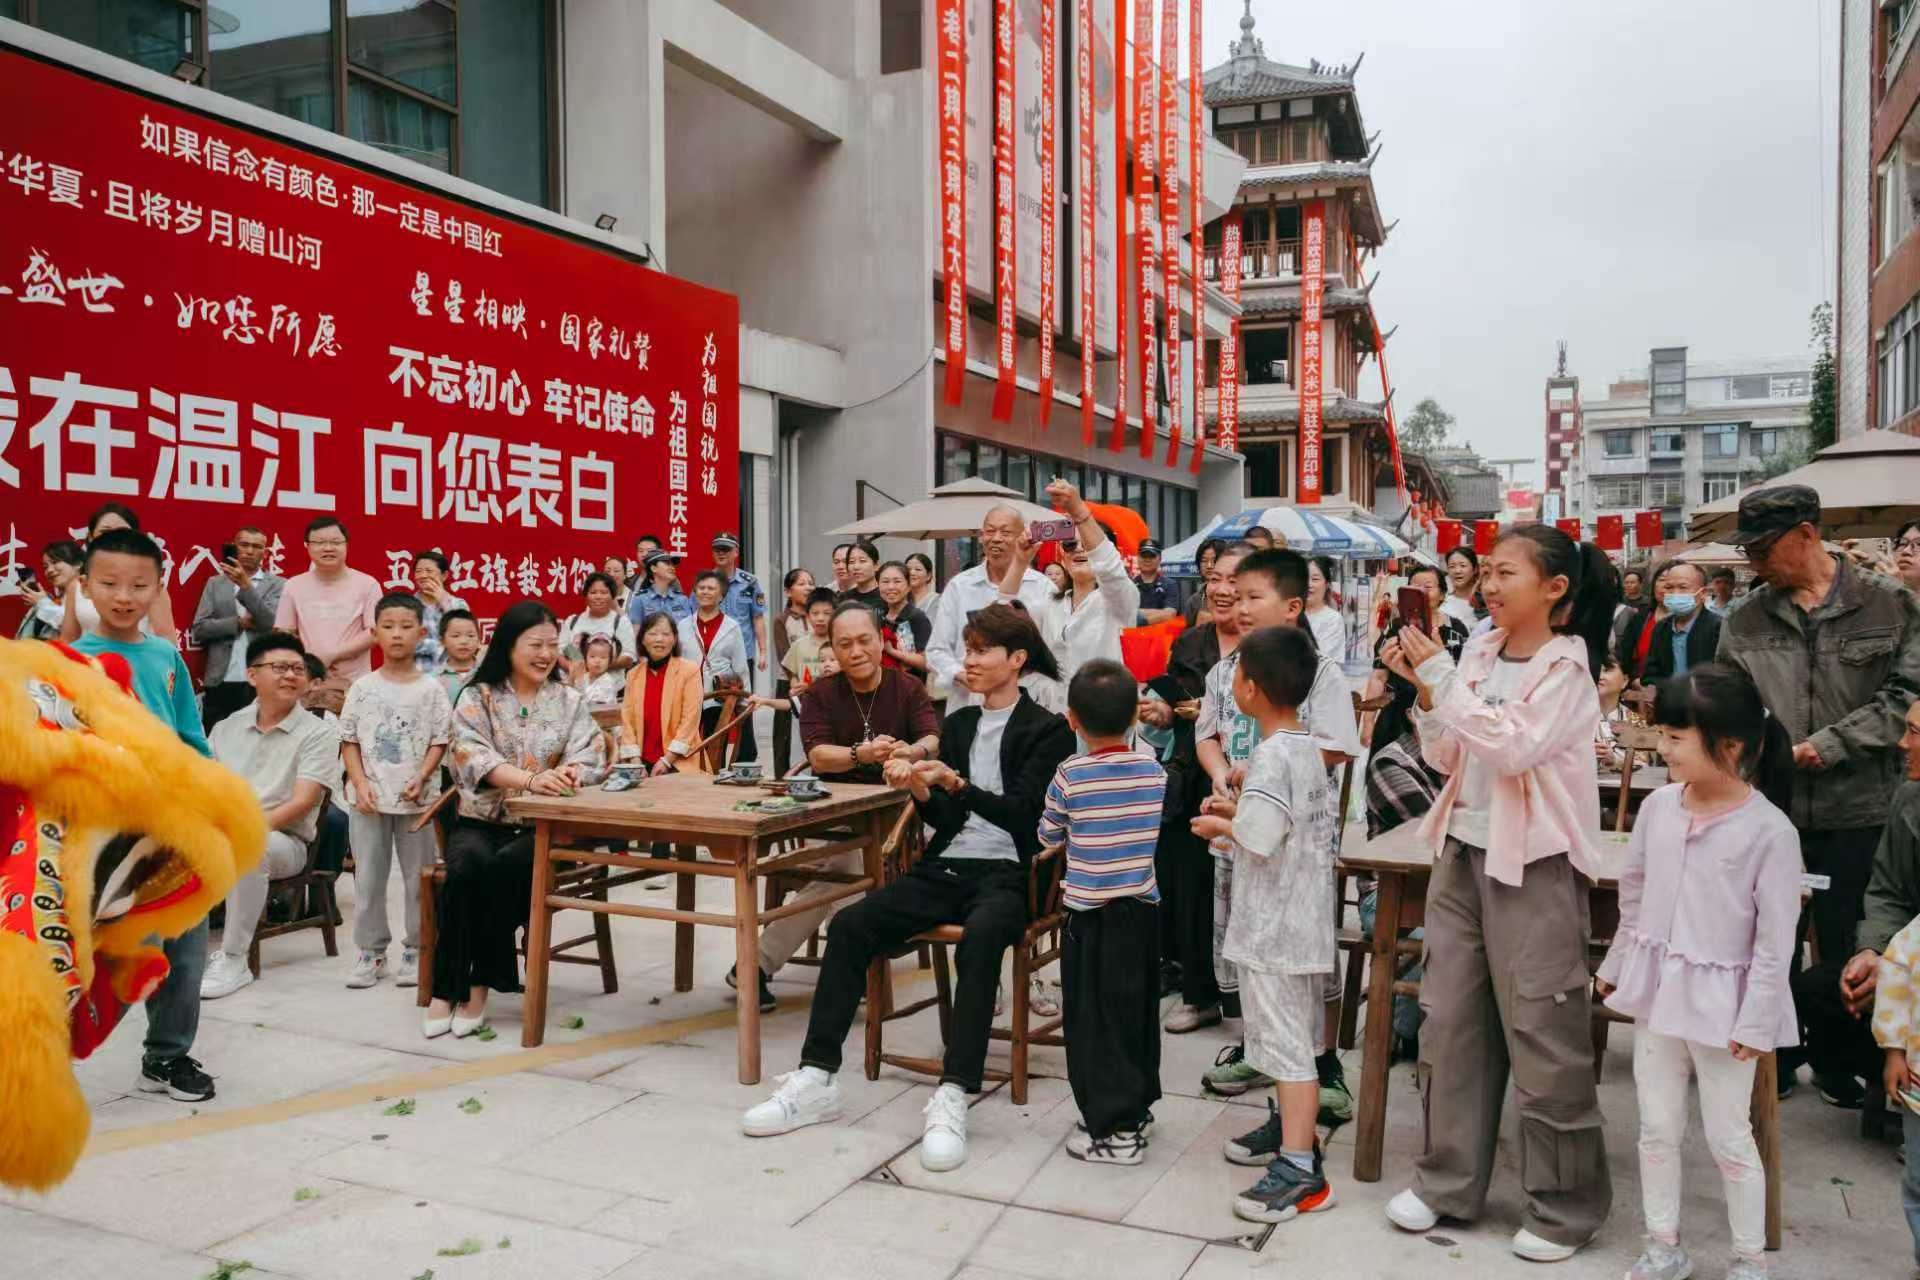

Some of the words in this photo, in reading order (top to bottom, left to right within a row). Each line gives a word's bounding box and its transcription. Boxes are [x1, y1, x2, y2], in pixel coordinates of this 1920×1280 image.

[0, 152, 322, 270] 华夏·且将岁月赠山河
[140, 113, 503, 258] 如果信念有颜色·那一定是中国红
[0, 246, 343, 359] 盛世·如您所愿
[0, 366, 336, 511] 在温江
[363, 421, 616, 533] 向您表白
[388, 345, 532, 417] 不忘初心
[543, 378, 657, 439] 牢记使命
[701, 331, 719, 496] 为祖国祝福
[669, 390, 688, 558] 为祖国庆生
[383, 546, 639, 597] 五红旗·我为你
